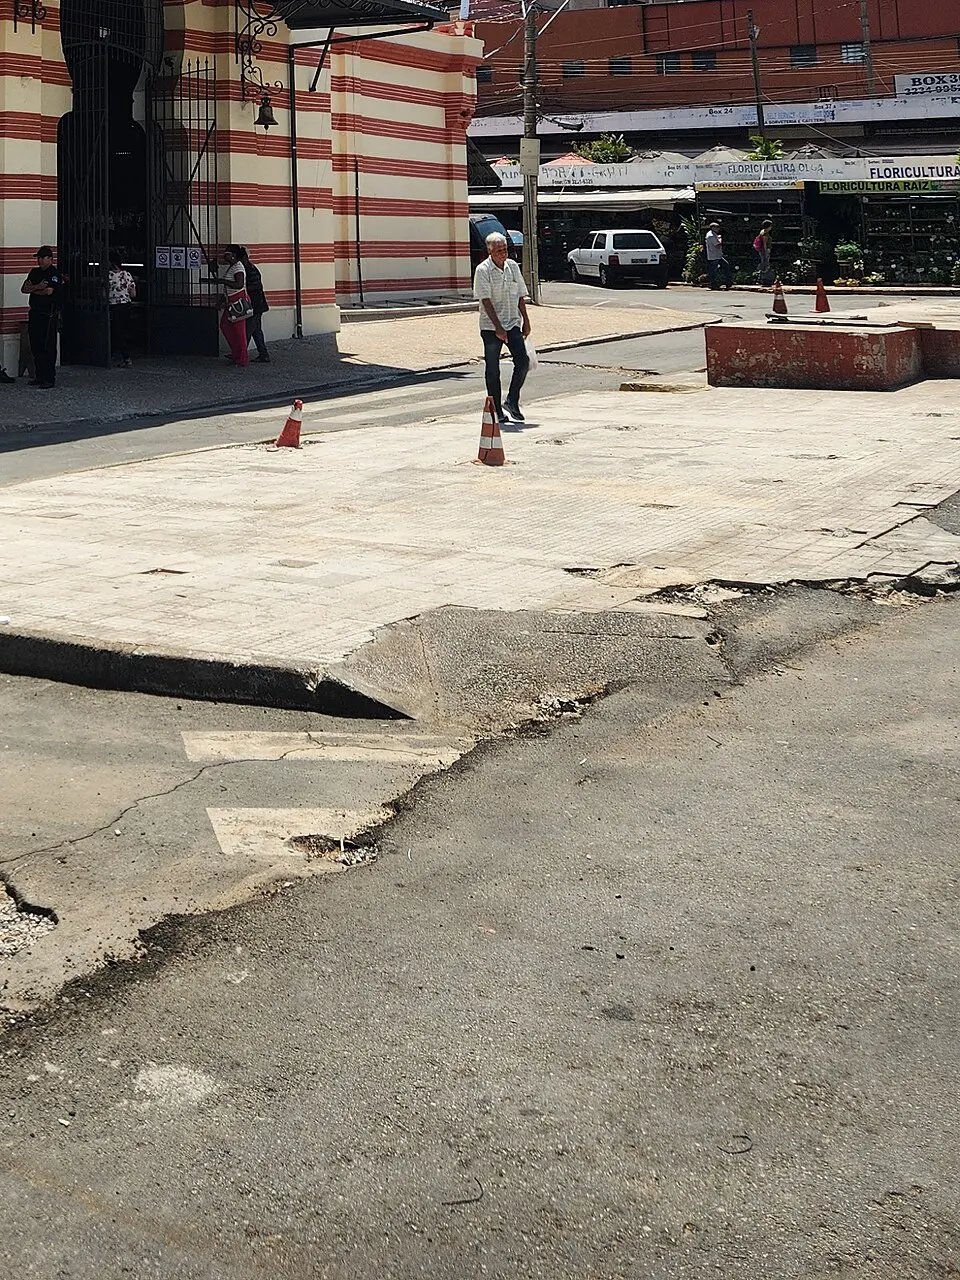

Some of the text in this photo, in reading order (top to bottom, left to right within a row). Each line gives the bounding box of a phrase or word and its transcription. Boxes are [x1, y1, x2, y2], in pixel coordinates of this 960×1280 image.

[728, 163, 795, 174] FLORICULTURA
[870, 166, 960, 179] FLORICULTURA
[820, 181, 900, 191] FLORICULTURA
[903, 181, 930, 191] RAIZ
